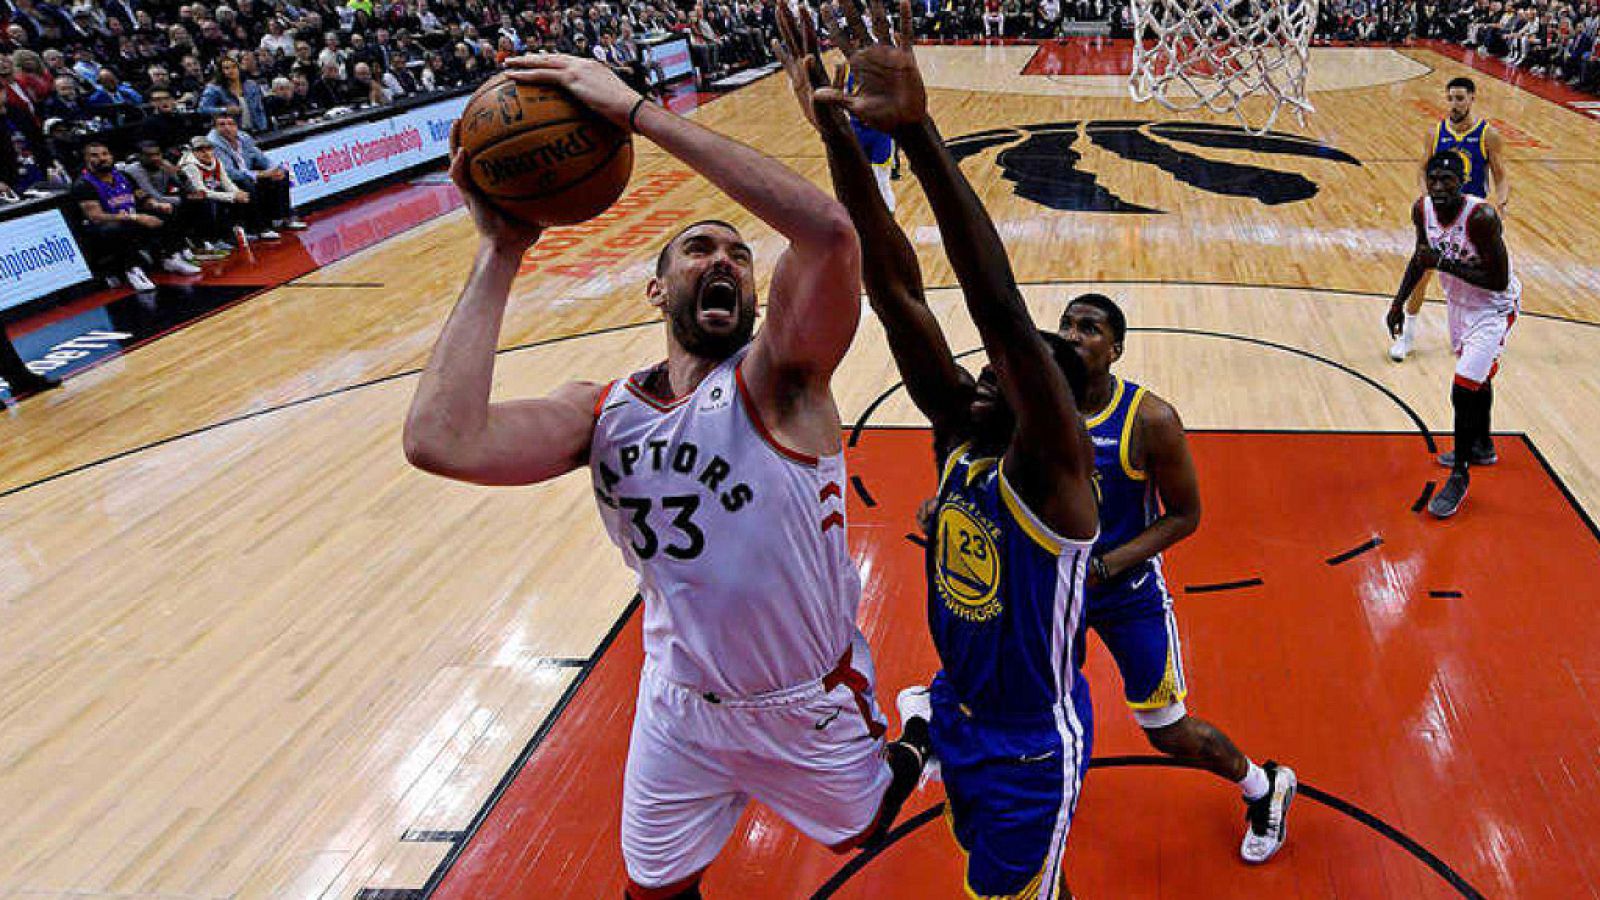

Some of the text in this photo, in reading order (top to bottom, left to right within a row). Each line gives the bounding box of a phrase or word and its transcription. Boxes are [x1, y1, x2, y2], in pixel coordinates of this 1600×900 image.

[316, 143, 353, 183] global
[351, 125, 423, 167] championship
[619, 494, 705, 561] 33
[958, 530, 988, 562] 23
